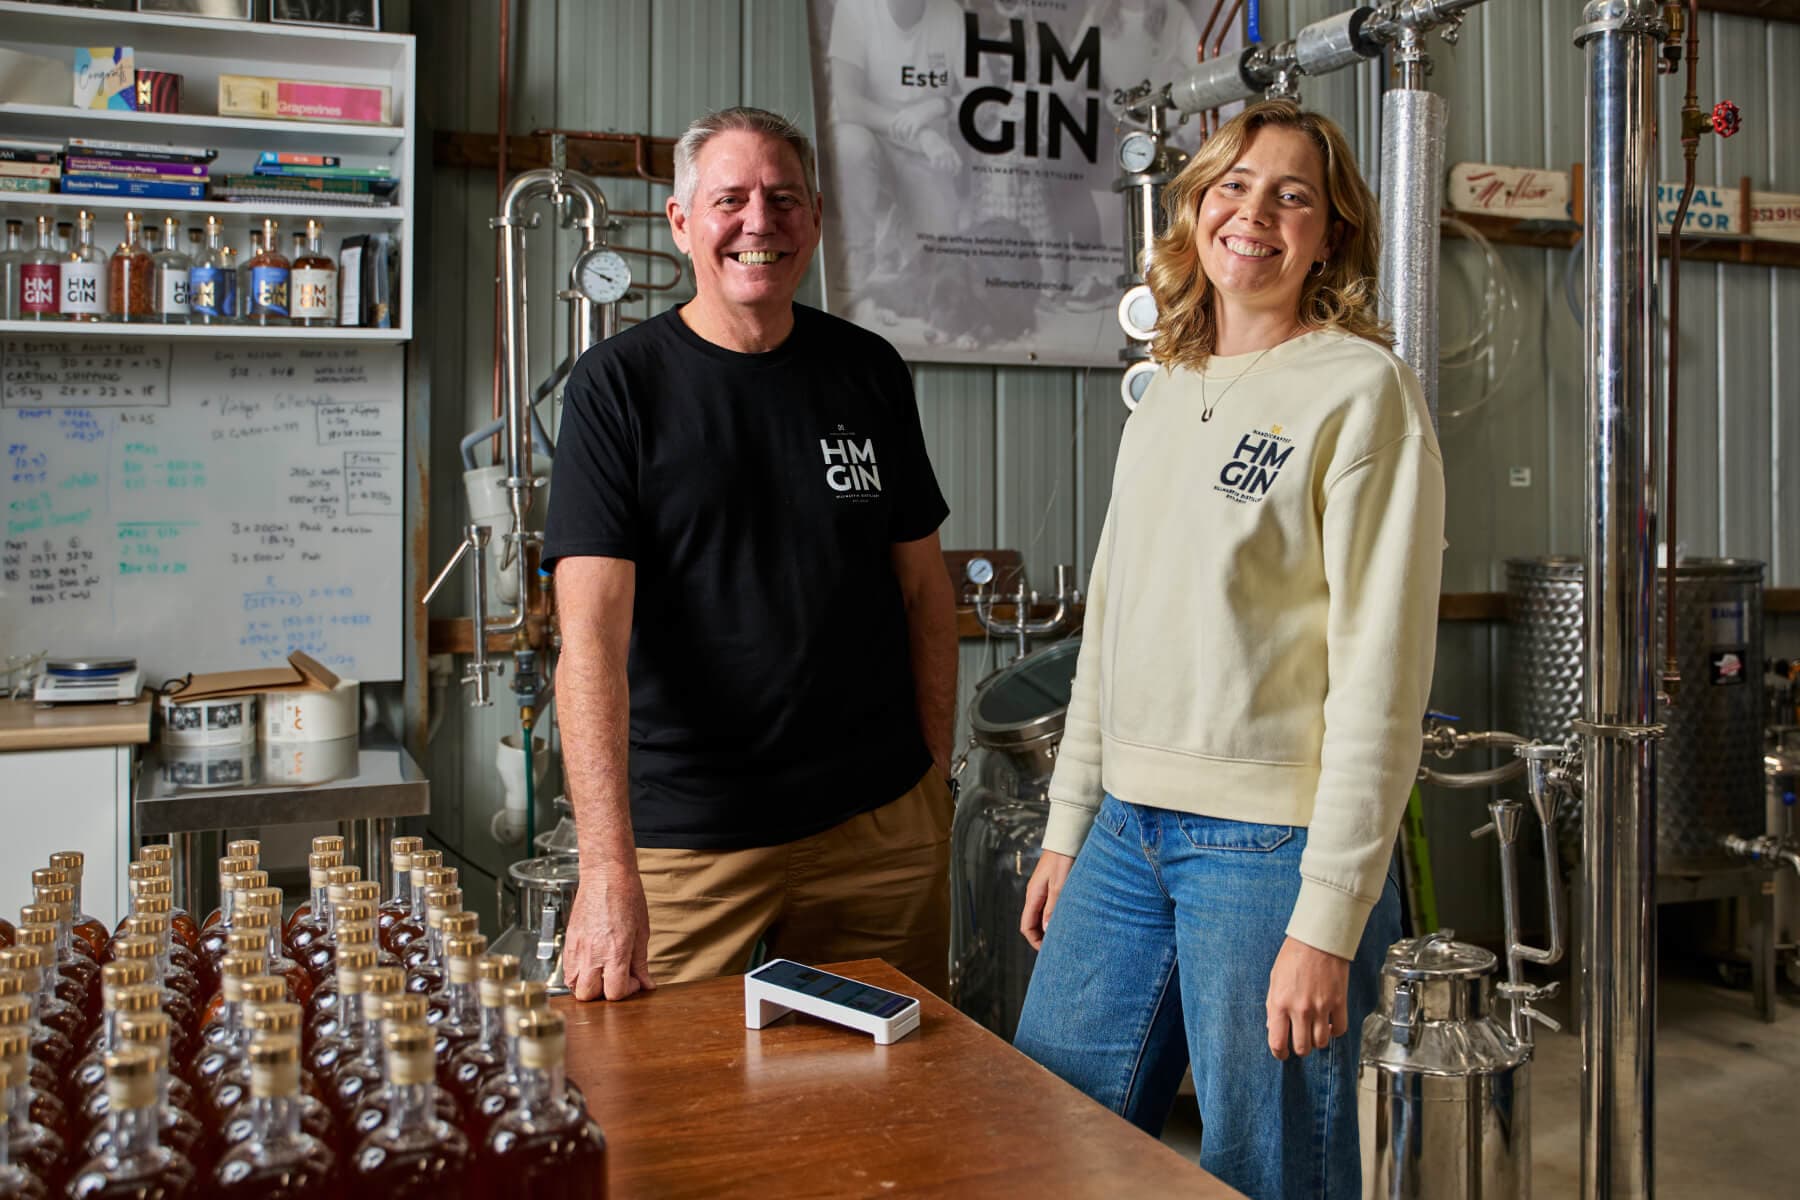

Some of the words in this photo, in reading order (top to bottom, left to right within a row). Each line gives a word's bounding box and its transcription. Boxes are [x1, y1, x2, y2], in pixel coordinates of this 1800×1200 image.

[964, 12, 1101, 91] HM
[278, 101, 343, 117] Grapevines
[959, 86, 1100, 164] GIN
[24, 278, 53, 290] HM
[68, 279, 96, 290] HM
[259, 280, 287, 293] HM
[301, 284, 327, 295] HM
[24, 290, 53, 304] GIN
[67, 290, 96, 303] GIN
[258, 293, 287, 307] GIN
[300, 296, 327, 308] GIN
[6, 371, 58, 383] CARTON
[65, 370, 121, 382] SHIPPING
[820, 438, 877, 465] HM
[1233, 434, 1295, 469] HM
[826, 464, 882, 492] GIN
[1219, 461, 1279, 495] GIN
